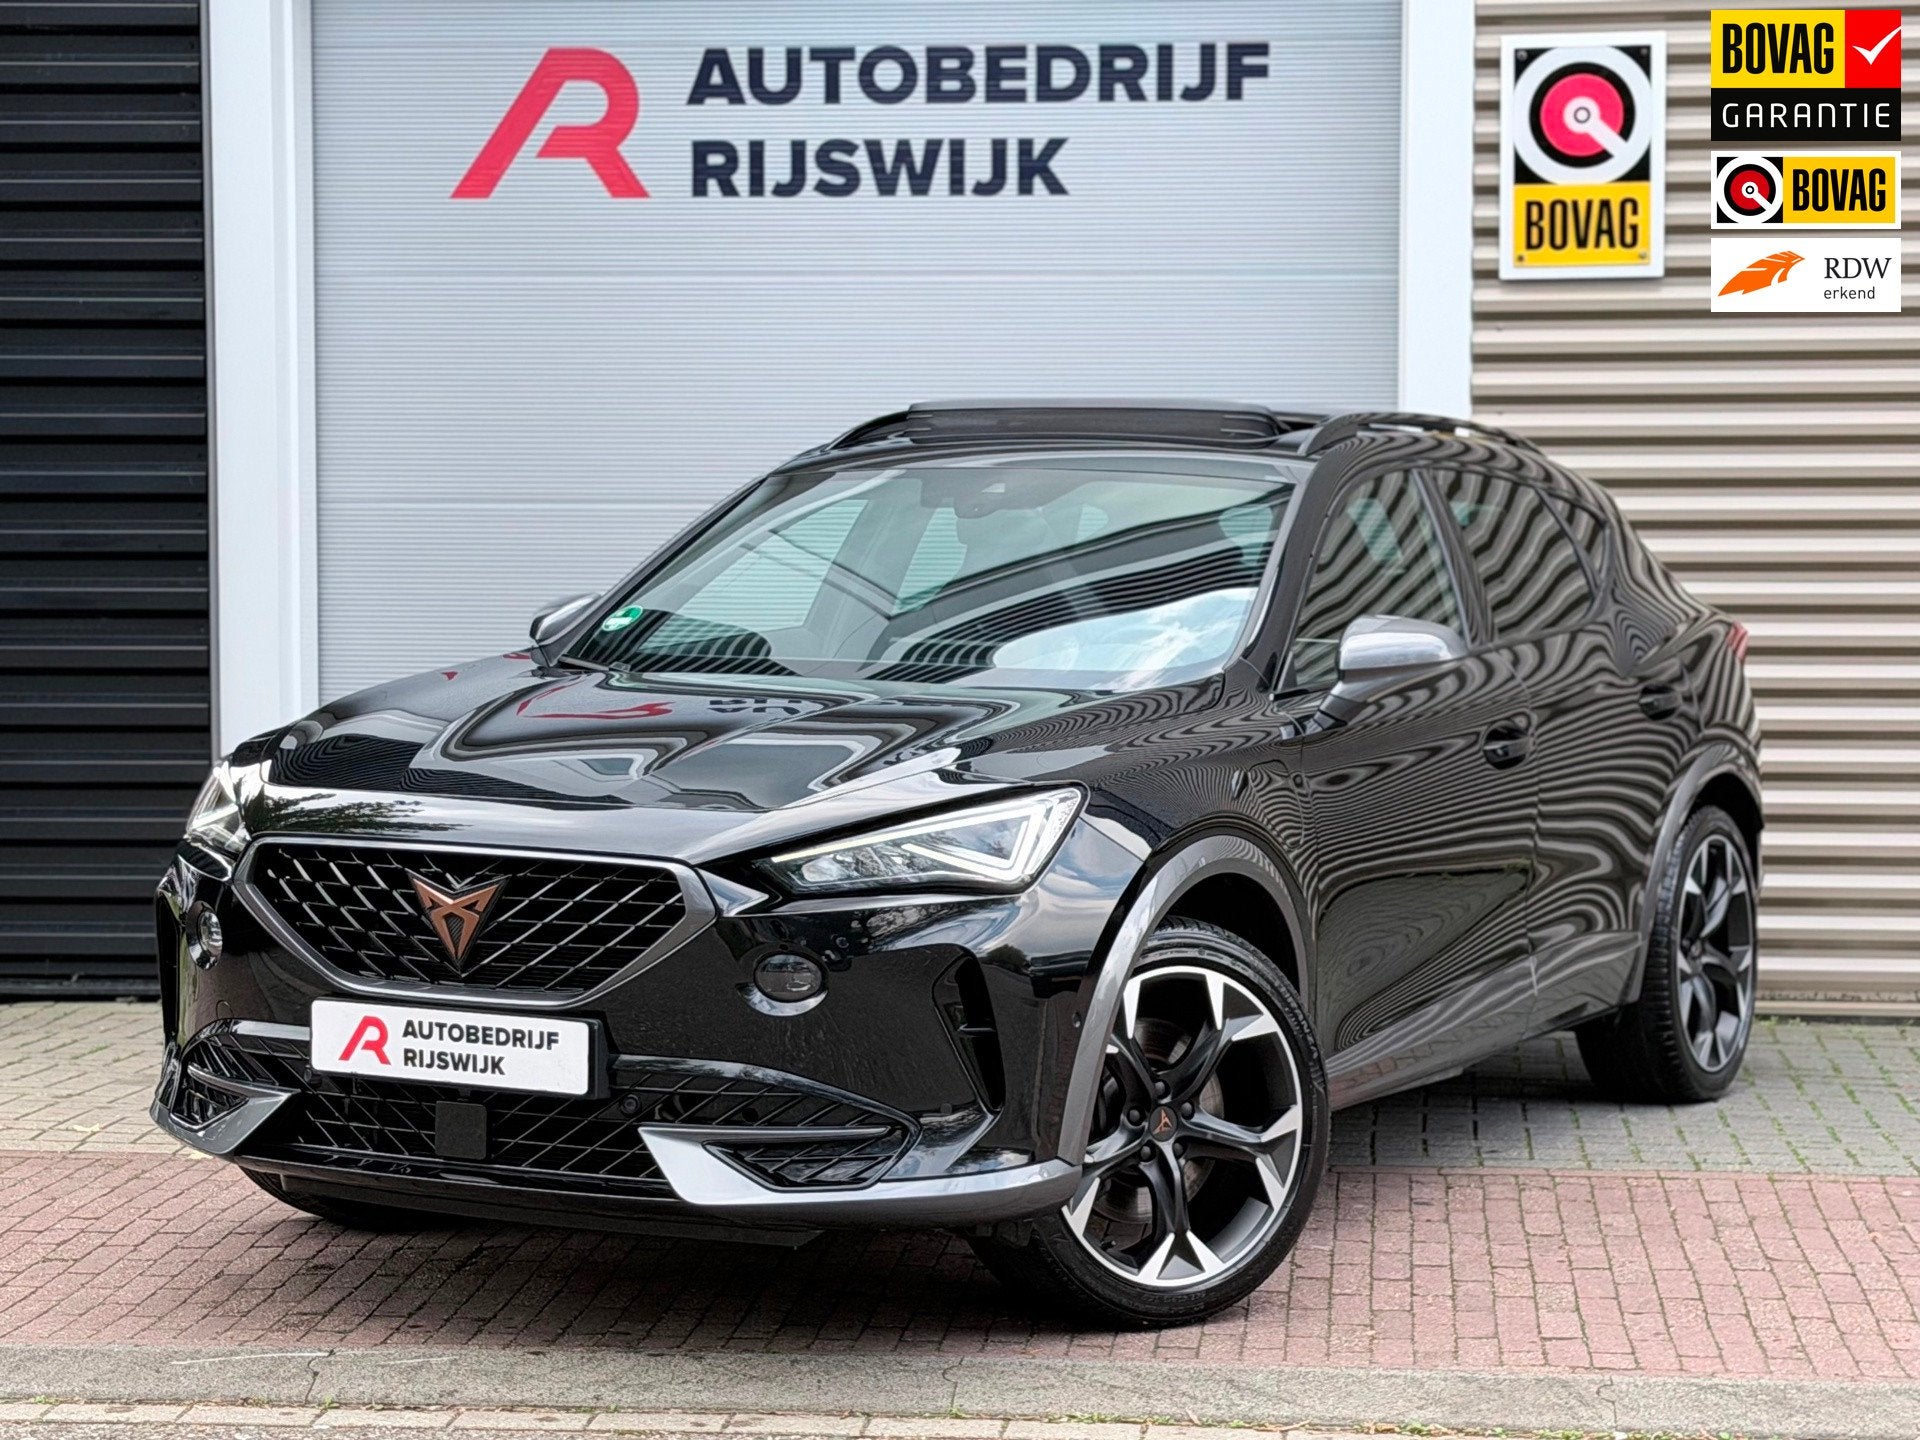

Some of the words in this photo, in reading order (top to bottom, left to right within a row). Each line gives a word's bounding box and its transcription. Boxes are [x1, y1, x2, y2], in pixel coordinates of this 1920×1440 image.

[686, 42, 1270, 106] AUTOBEDRIJF
[690, 137, 1070, 197] RIJSWIJK
[1525, 197, 1639, 250] BOVAG
[402, 1019, 559, 1050] AUTOBEDRIJF
[403, 1048, 505, 1075] RIJSWIJK
